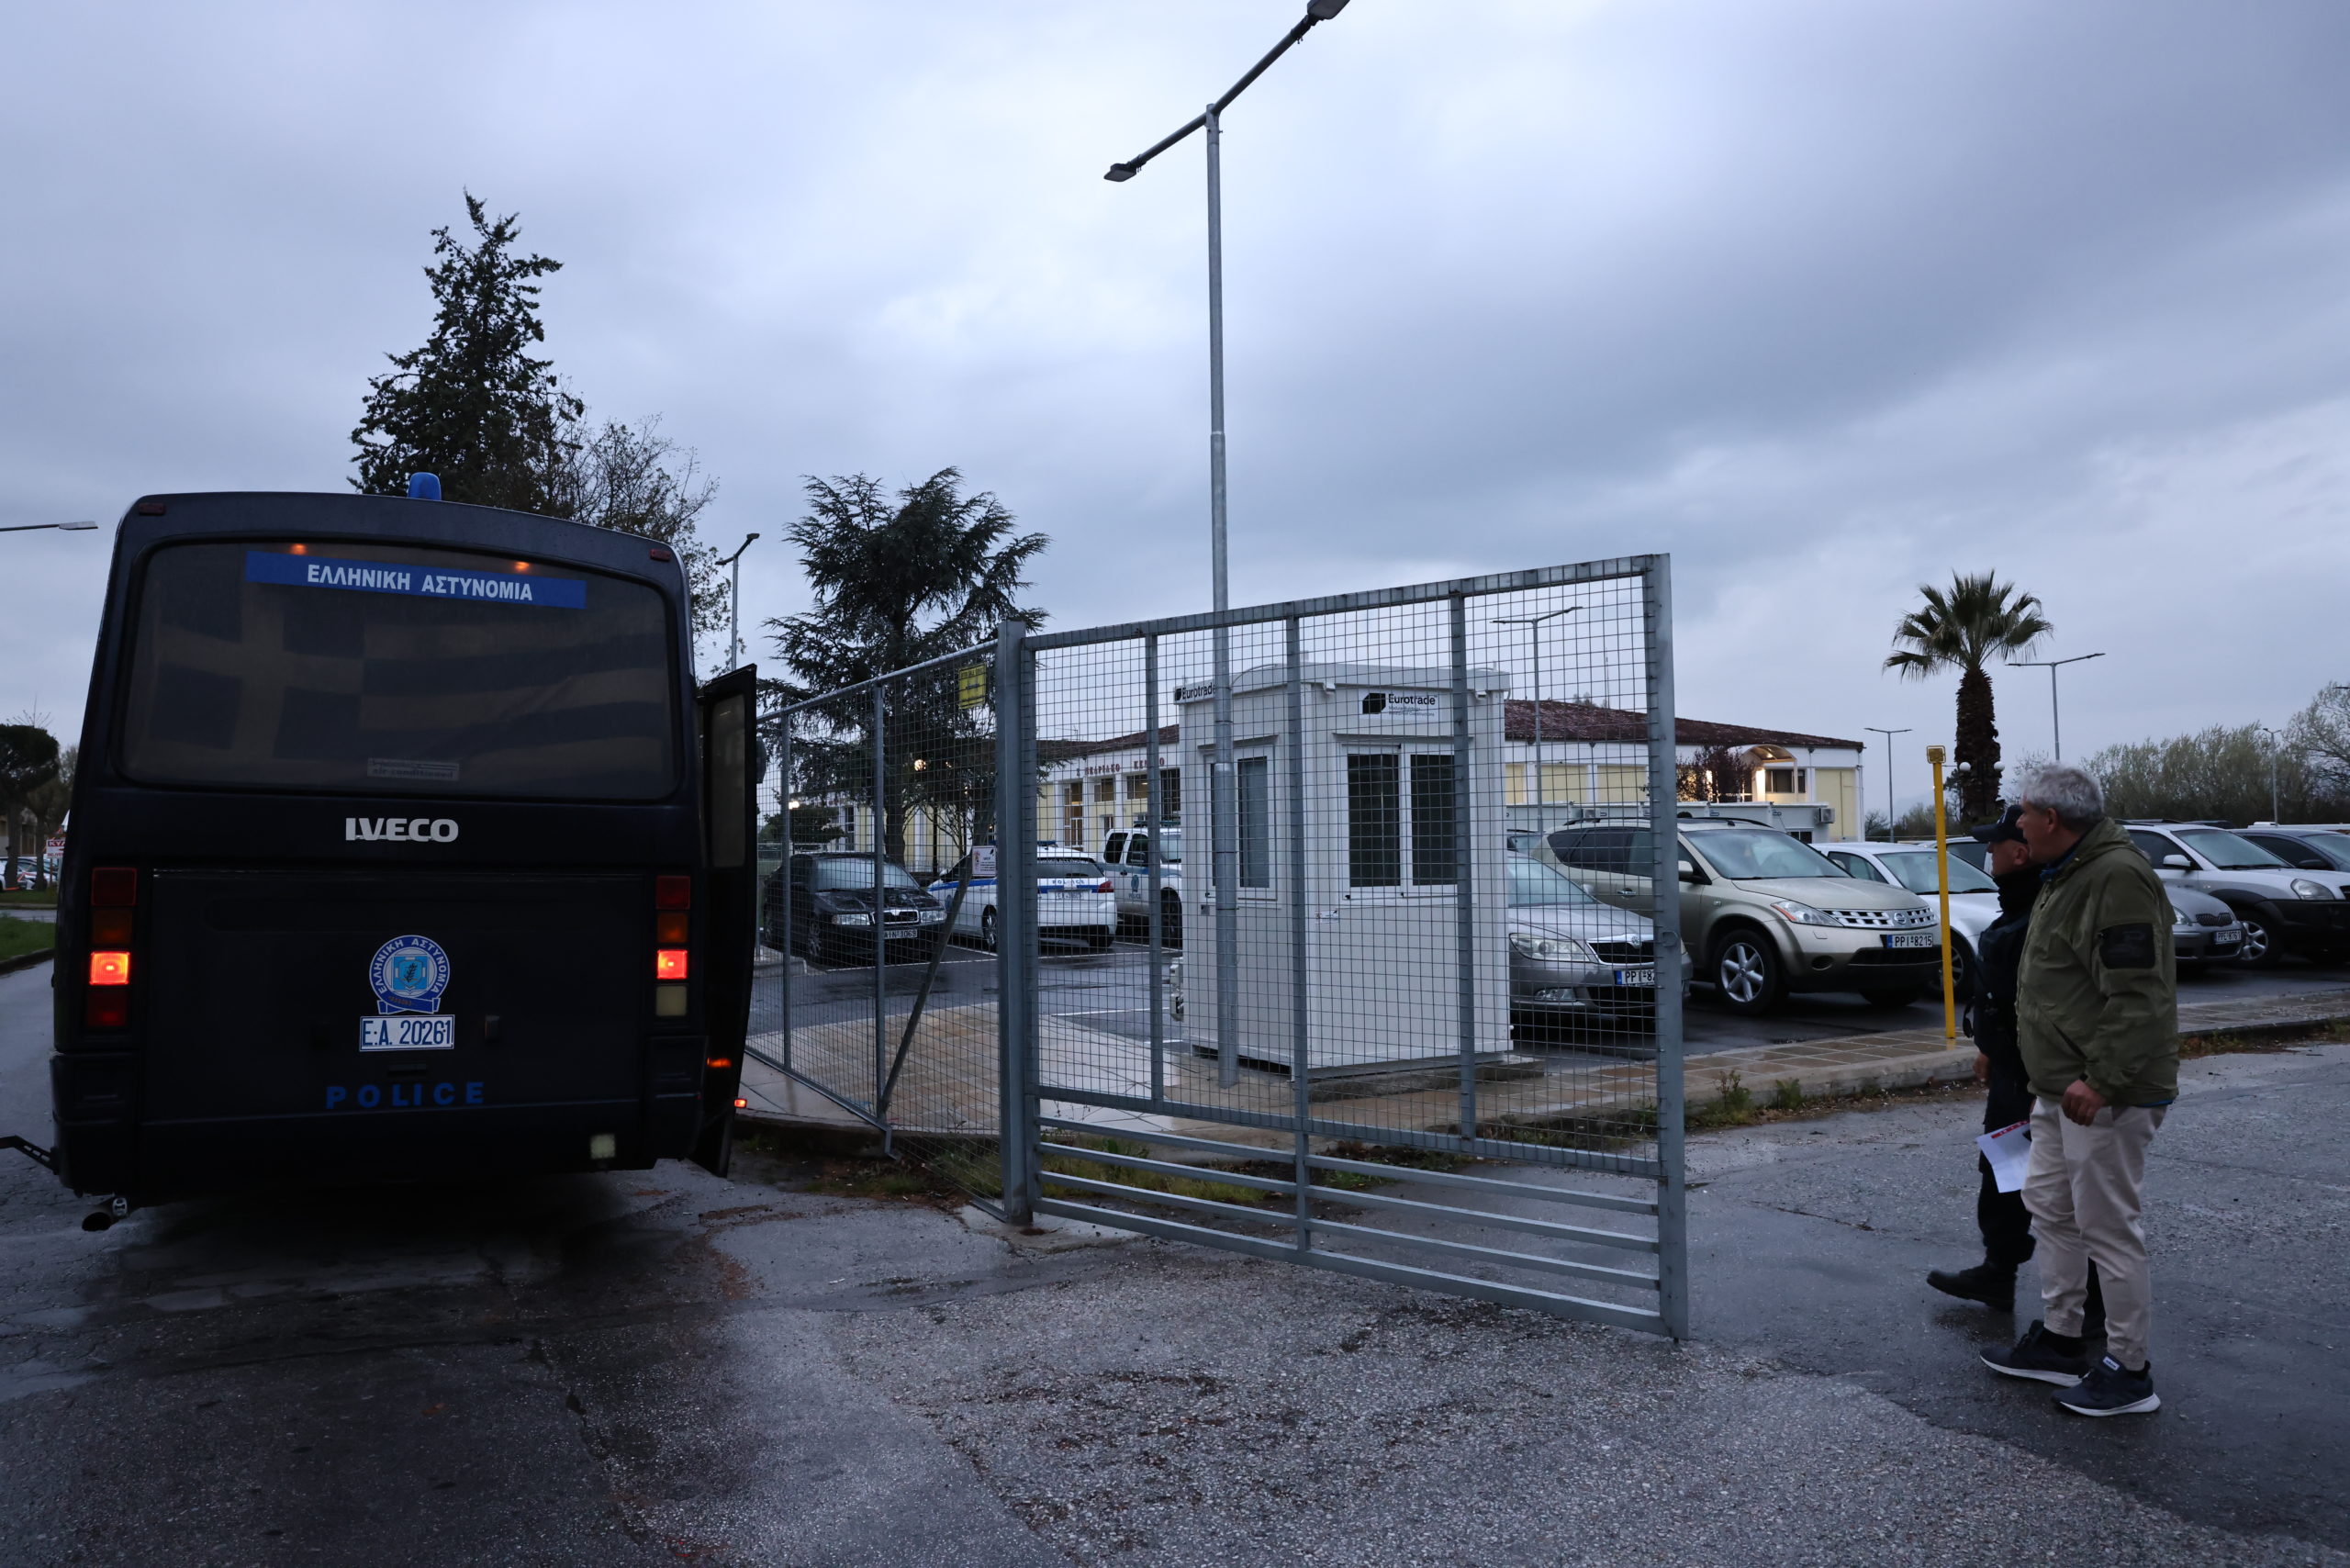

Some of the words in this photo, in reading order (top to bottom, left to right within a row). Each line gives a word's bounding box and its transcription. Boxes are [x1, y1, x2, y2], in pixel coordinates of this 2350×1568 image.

[307, 564, 411, 590] ΕΛΛΗΝΙΚΗ
[421, 575, 533, 601] ΑΣΤΥΝΟΜΙΑ
[345, 817, 459, 843] IVECO
[373, 938, 404, 994] ΕΛΛΗΝΙΚΗ
[411, 937, 448, 993] ΑΣΤΥΝΟΜΙΑ
[399, 1019, 451, 1045] 20261
[324, 1081, 486, 1110] POLICE
